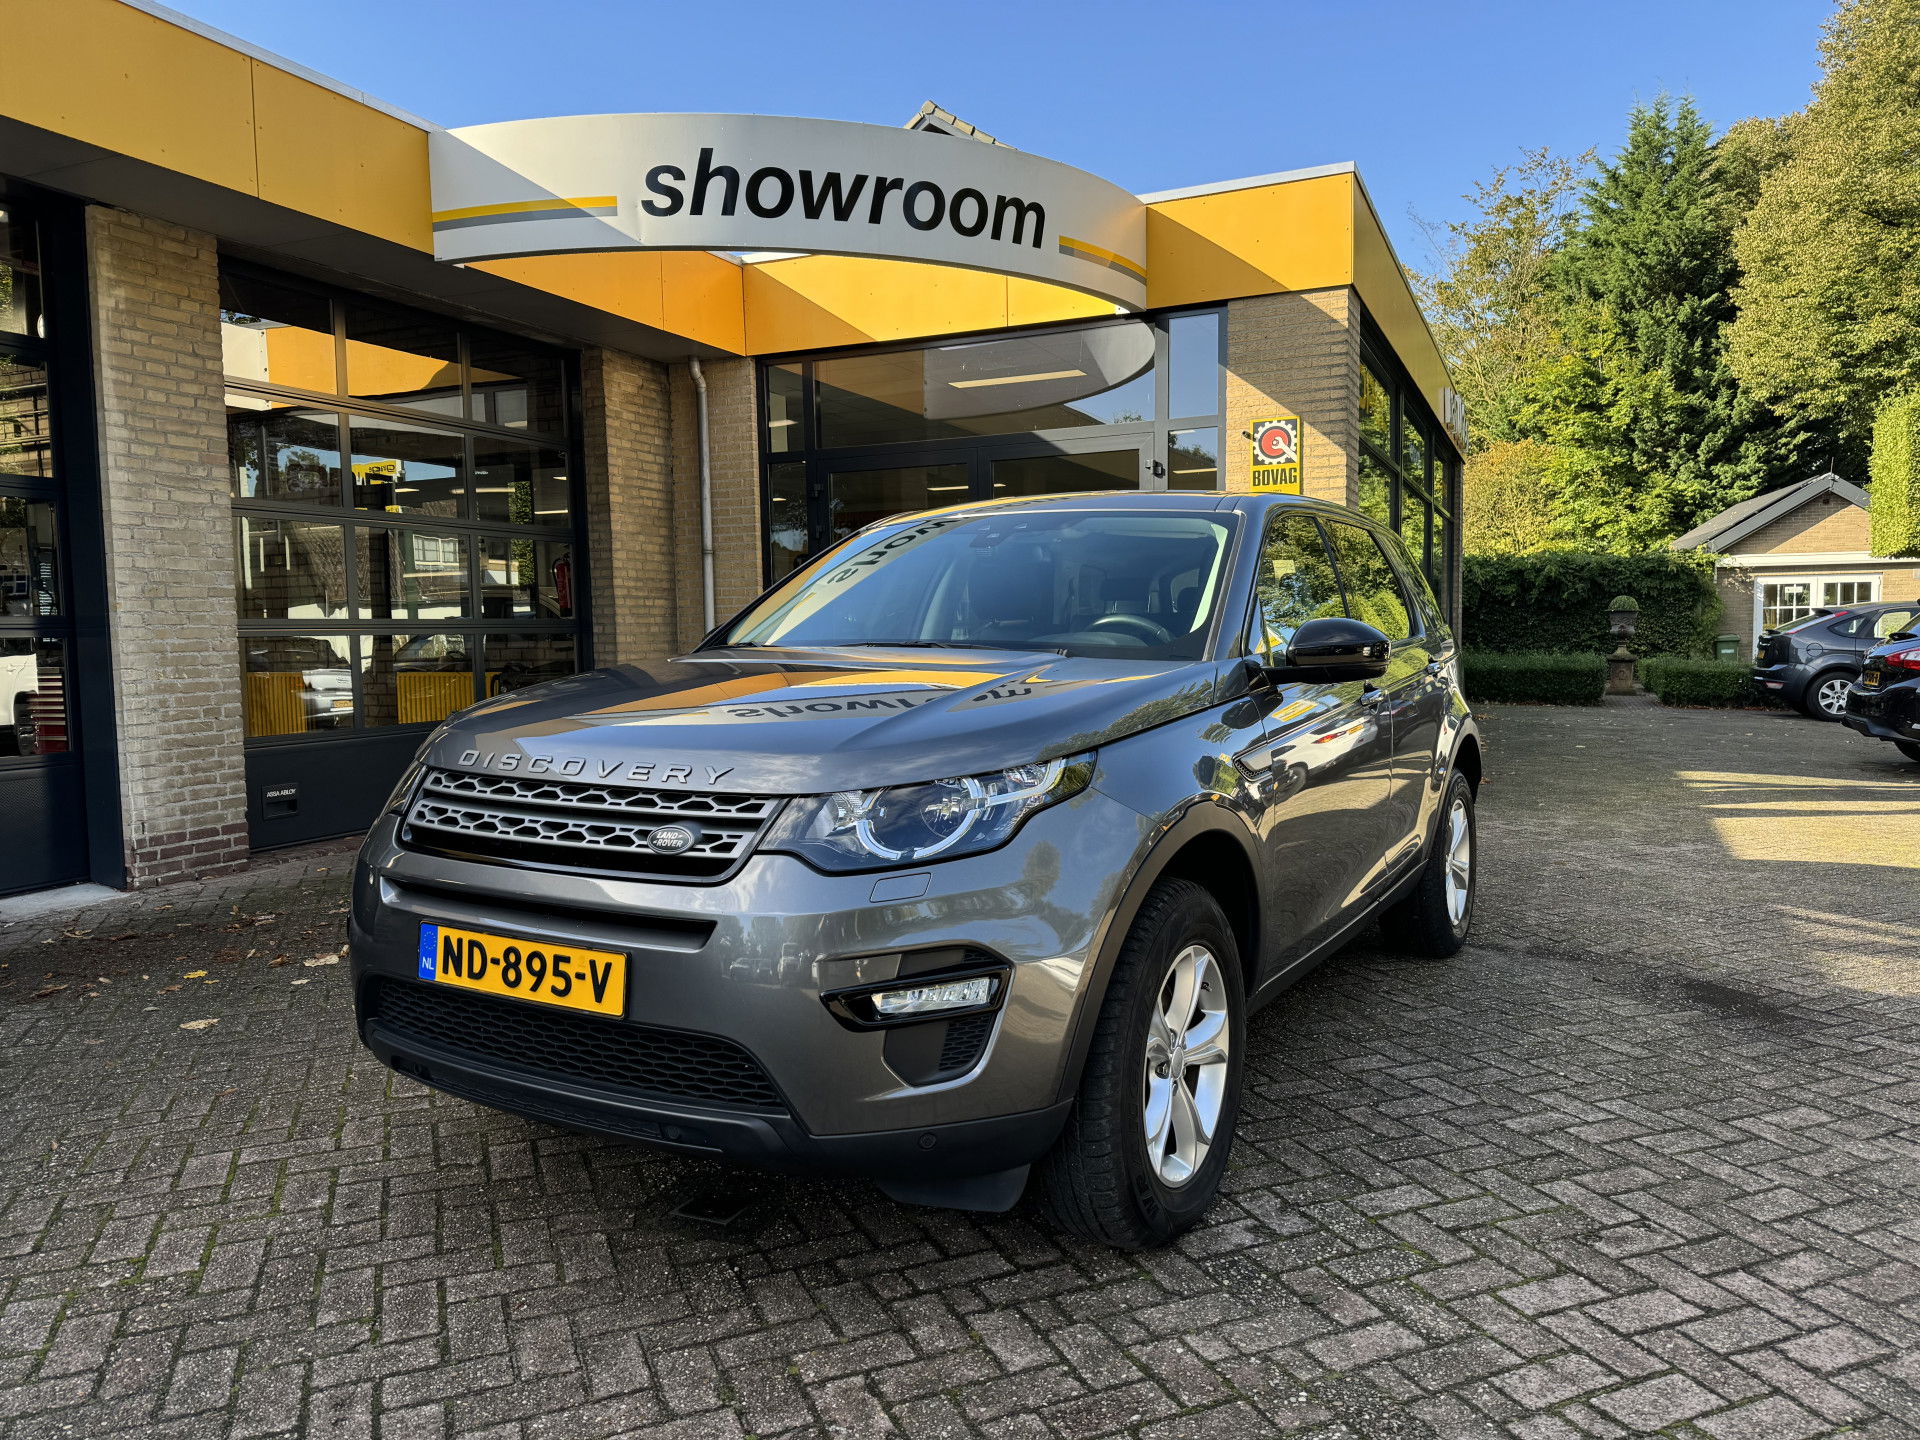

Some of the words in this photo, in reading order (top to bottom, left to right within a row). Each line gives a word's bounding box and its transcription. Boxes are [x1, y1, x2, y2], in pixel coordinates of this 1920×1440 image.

[641, 147, 1046, 249] showroom
[1252, 467, 1298, 487] BOVAG
[457, 750, 735, 785] DISCOVERY
[266, 790, 280, 798] ASSA
[280, 788, 297, 796] ABLOY
[656, 831, 679, 839] LAND
[656, 838, 684, 847] ROVER
[421, 956, 435, 970] NL
[441, 934, 613, 1004] ND-895-V
